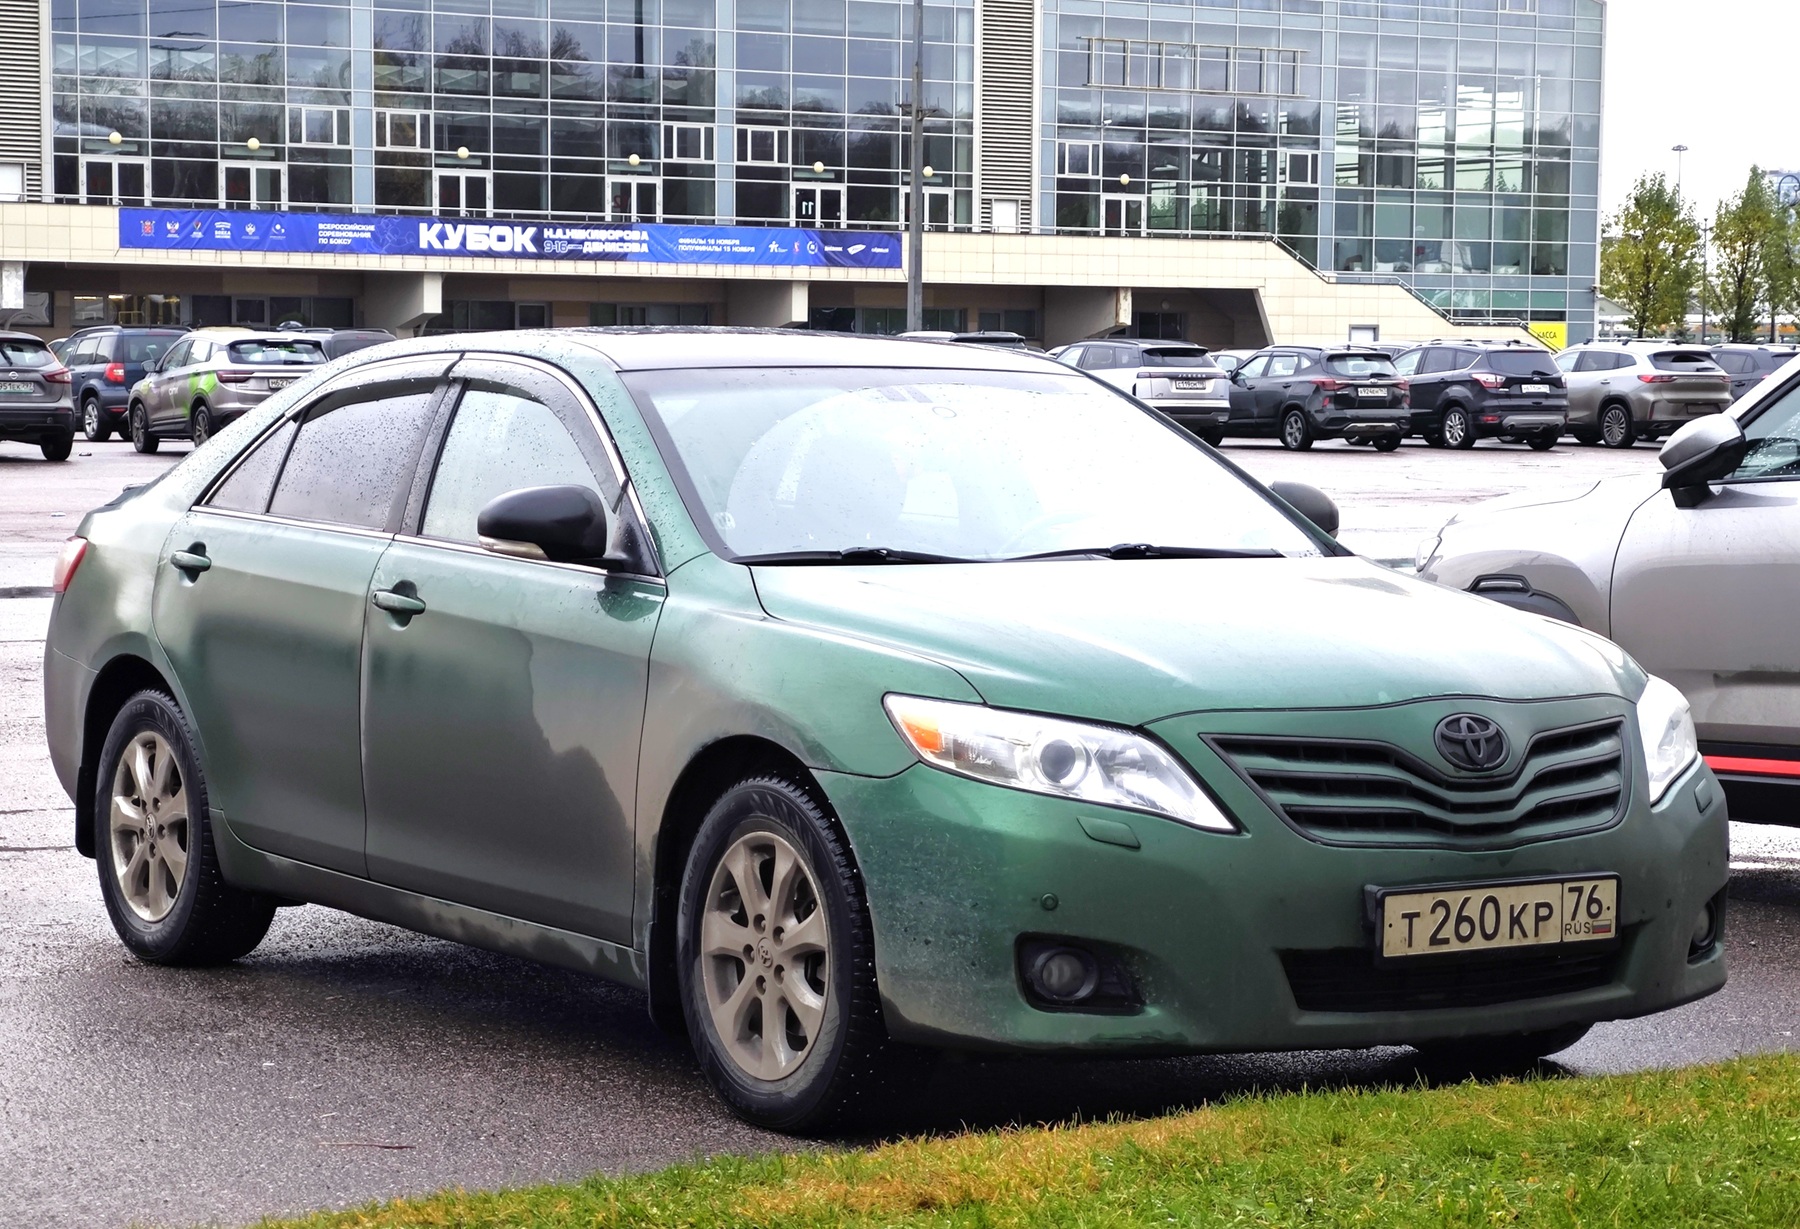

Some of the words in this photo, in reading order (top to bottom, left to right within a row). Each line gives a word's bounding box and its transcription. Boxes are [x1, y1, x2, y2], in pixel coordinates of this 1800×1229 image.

[318, 223, 375, 231] ВСЕРОССИЙСКИЕ
[419, 222, 538, 253] КУБОК
[678, 237, 707, 245] ФИНАЛЫ
[582, 241, 649, 253] ДЕНИСОВА
[1401, 895, 1554, 948] Т260КР
[1568, 884, 1604, 922] 76
[1564, 921, 1592, 936] RUS
